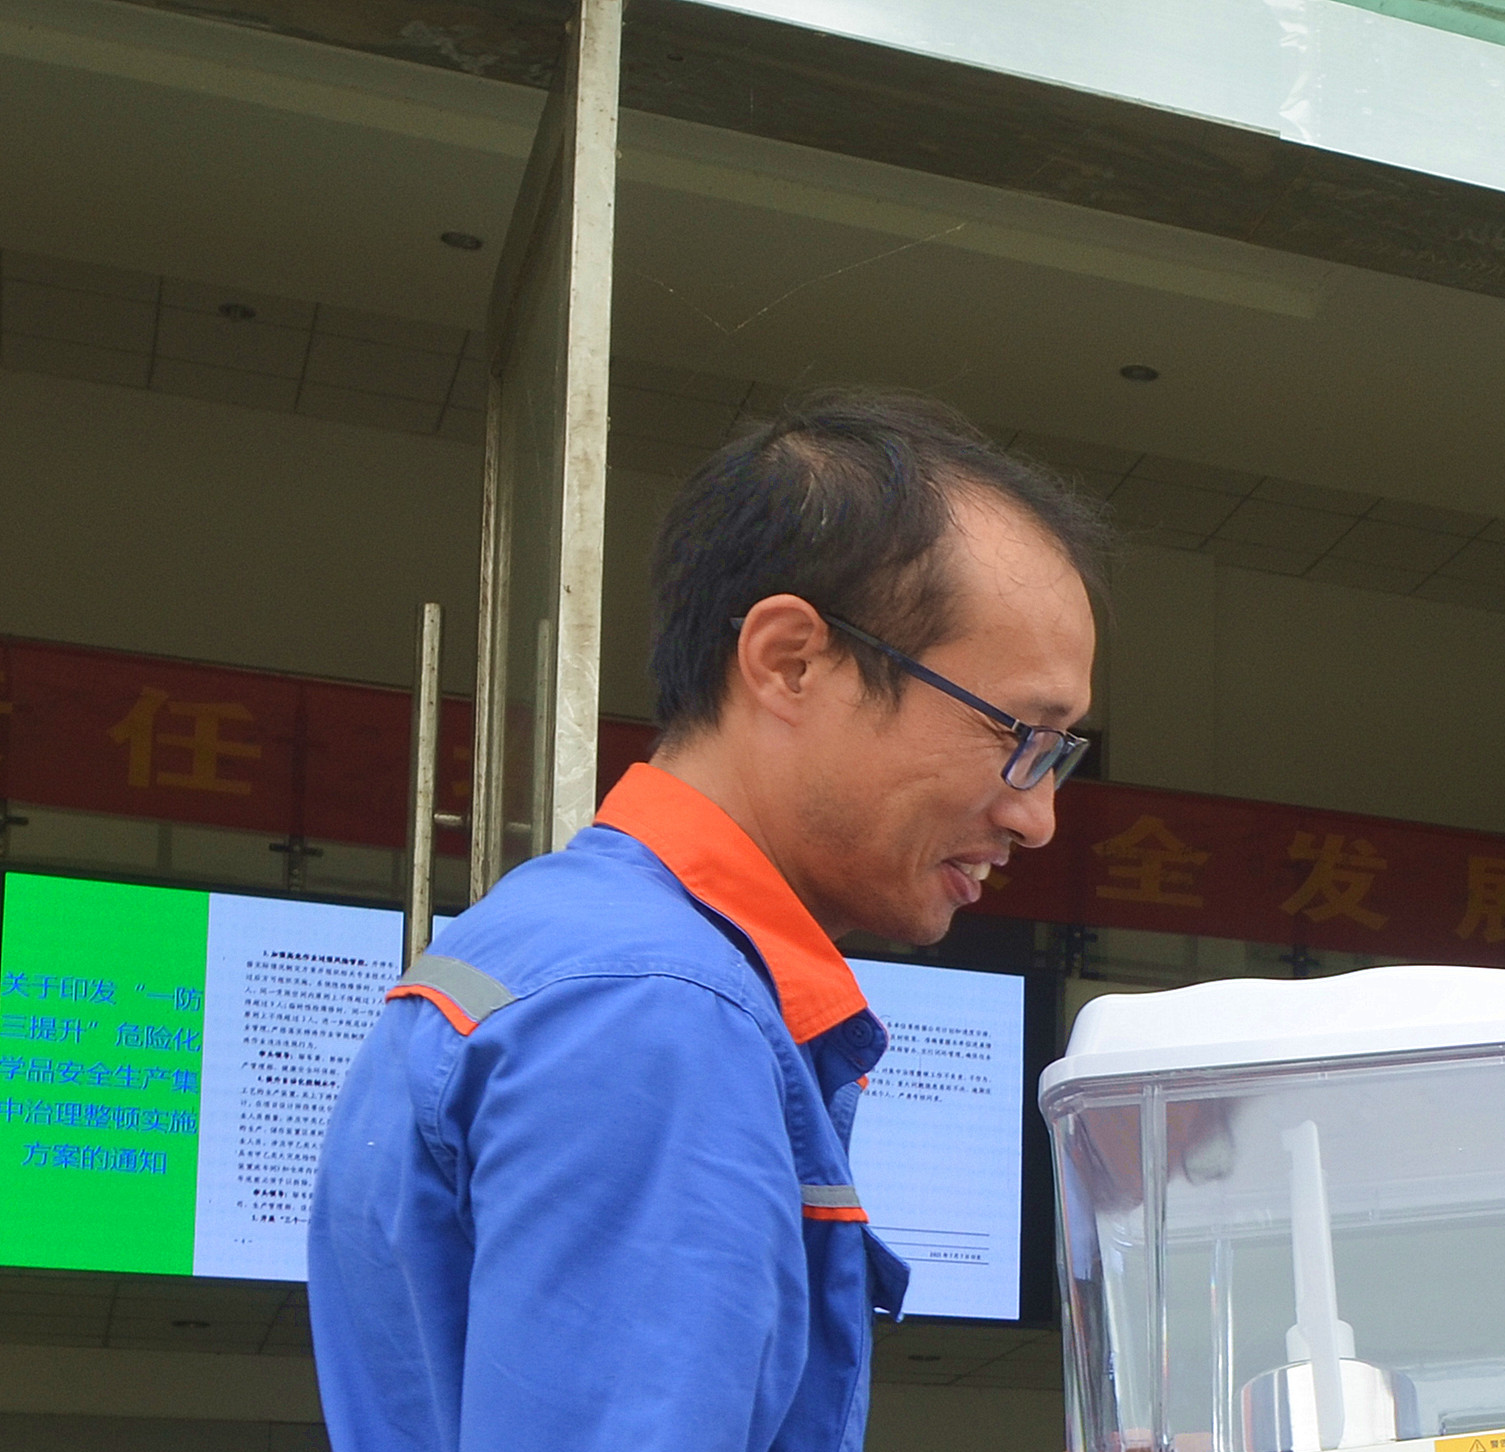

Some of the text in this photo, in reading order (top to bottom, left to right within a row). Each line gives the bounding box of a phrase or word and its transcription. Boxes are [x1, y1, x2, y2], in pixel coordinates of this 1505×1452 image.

[0, 1055, 199, 1095] 学品安全生产集
[0, 1097, 198, 1136] 中治理整顿实施
[21, 1141, 168, 1175] 方案的通知
